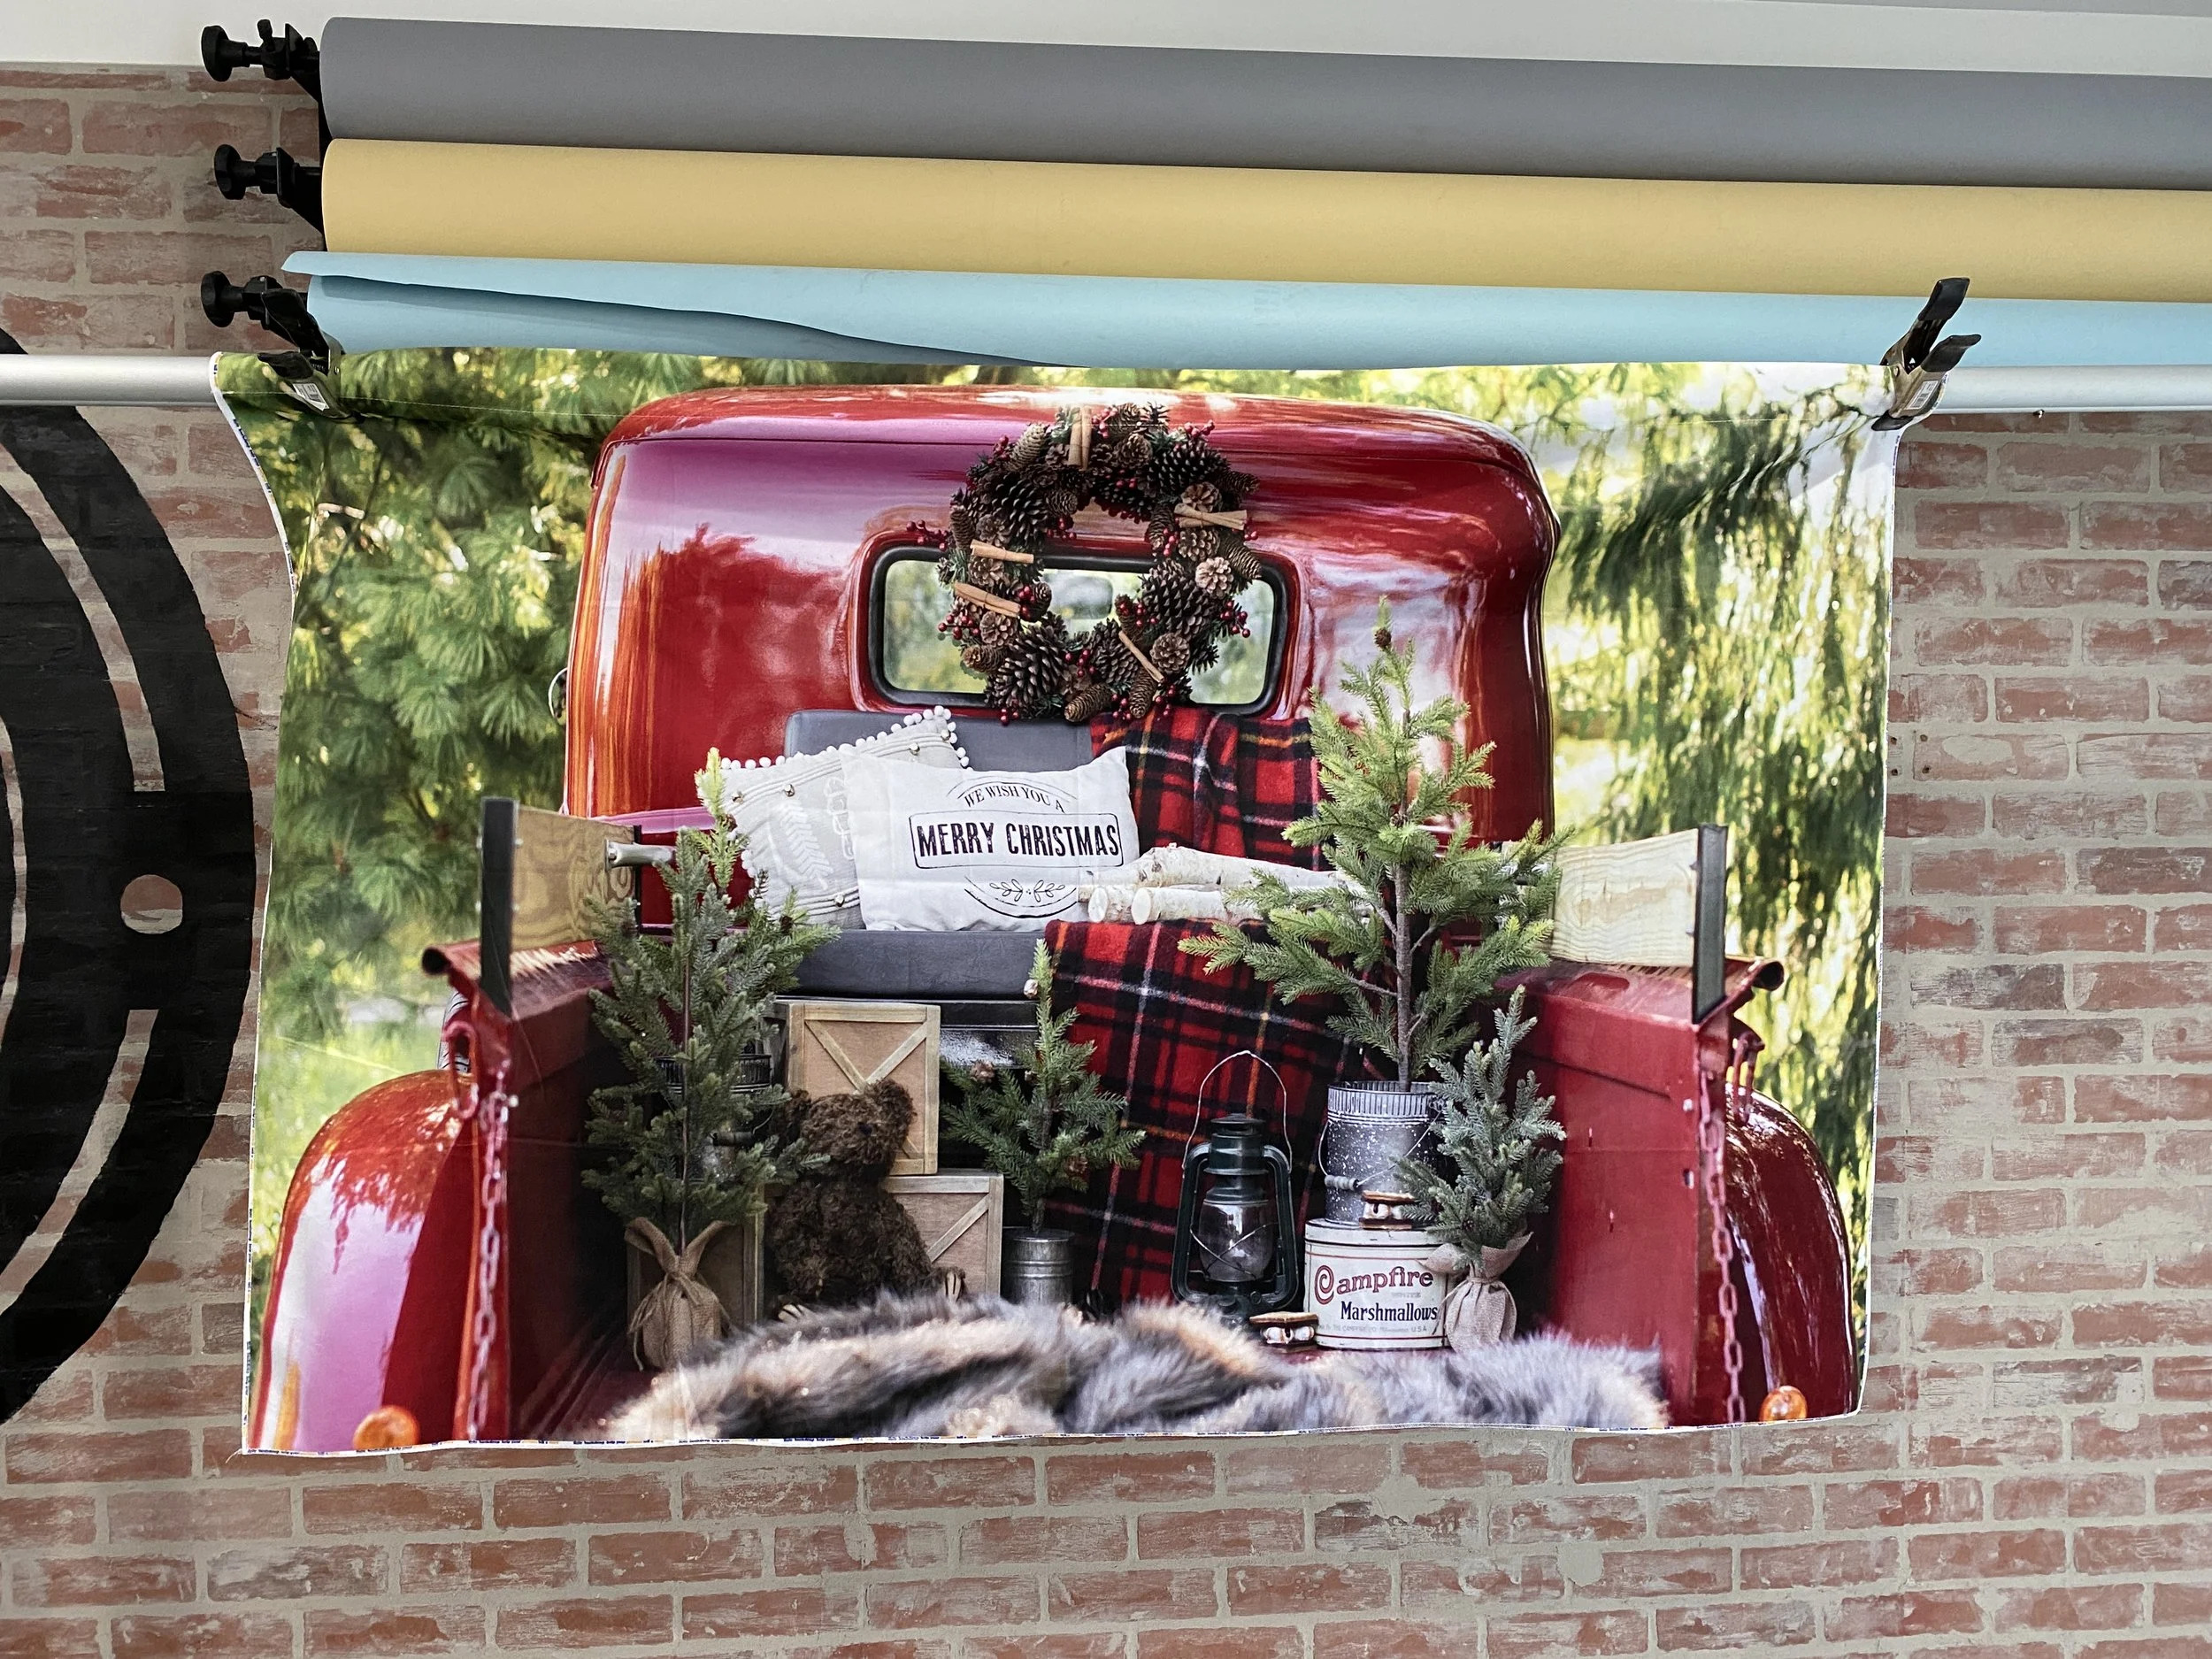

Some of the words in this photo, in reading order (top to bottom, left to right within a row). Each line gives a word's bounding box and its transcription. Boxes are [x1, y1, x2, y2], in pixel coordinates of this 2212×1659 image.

[964, 788, 985, 808] WE
[985, 786, 1020, 798] WISH
[1021, 787, 1050, 806] YOU
[1056, 799, 1065, 813] A
[917, 822, 995, 857] MERRY
[1005, 823, 1120, 856] CHRISTMAS
[1314, 1264, 1434, 1305] Campfire
[1340, 1301, 1438, 1322] Marshmallows
